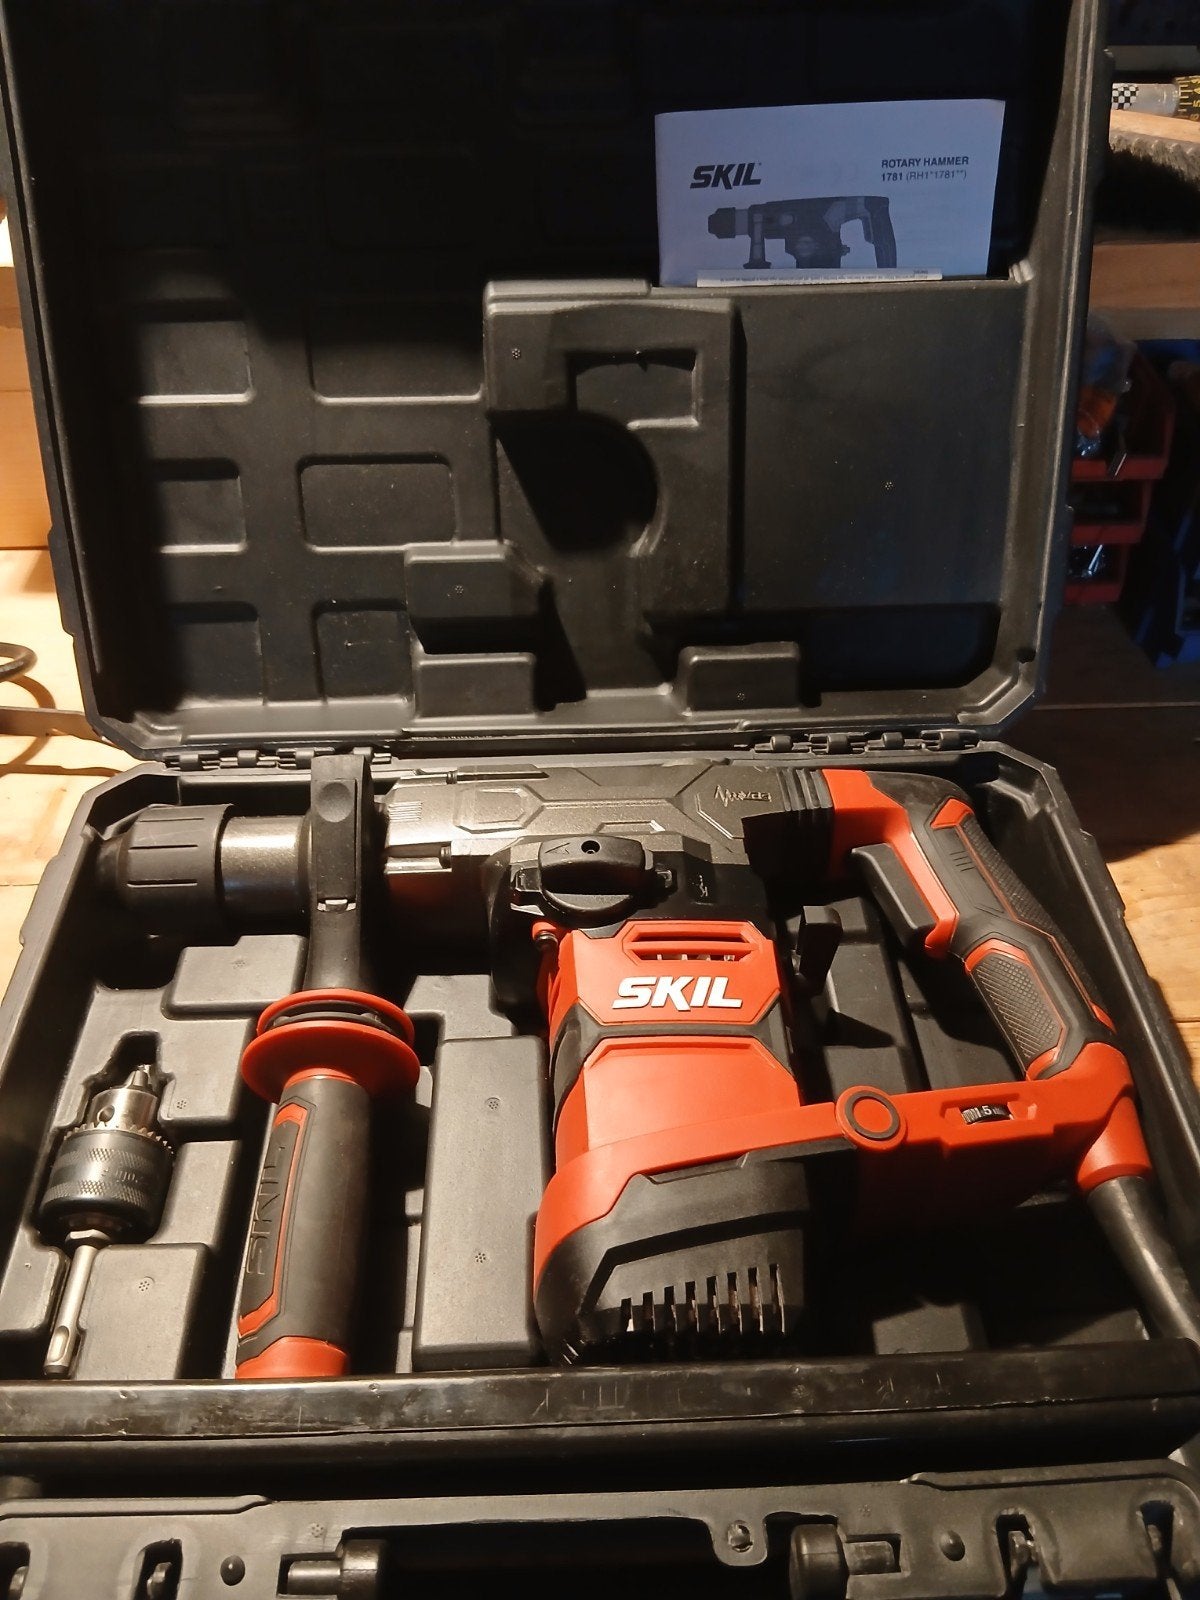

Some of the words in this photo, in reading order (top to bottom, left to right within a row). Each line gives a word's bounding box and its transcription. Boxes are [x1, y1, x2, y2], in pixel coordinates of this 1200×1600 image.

[881, 159, 921, 168] ROTARY
[923, 156, 969, 166] HAMMER
[690, 162, 762, 189] SKIL
[881, 172, 903, 181] 1781
[612, 976, 743, 1011] SKIL
